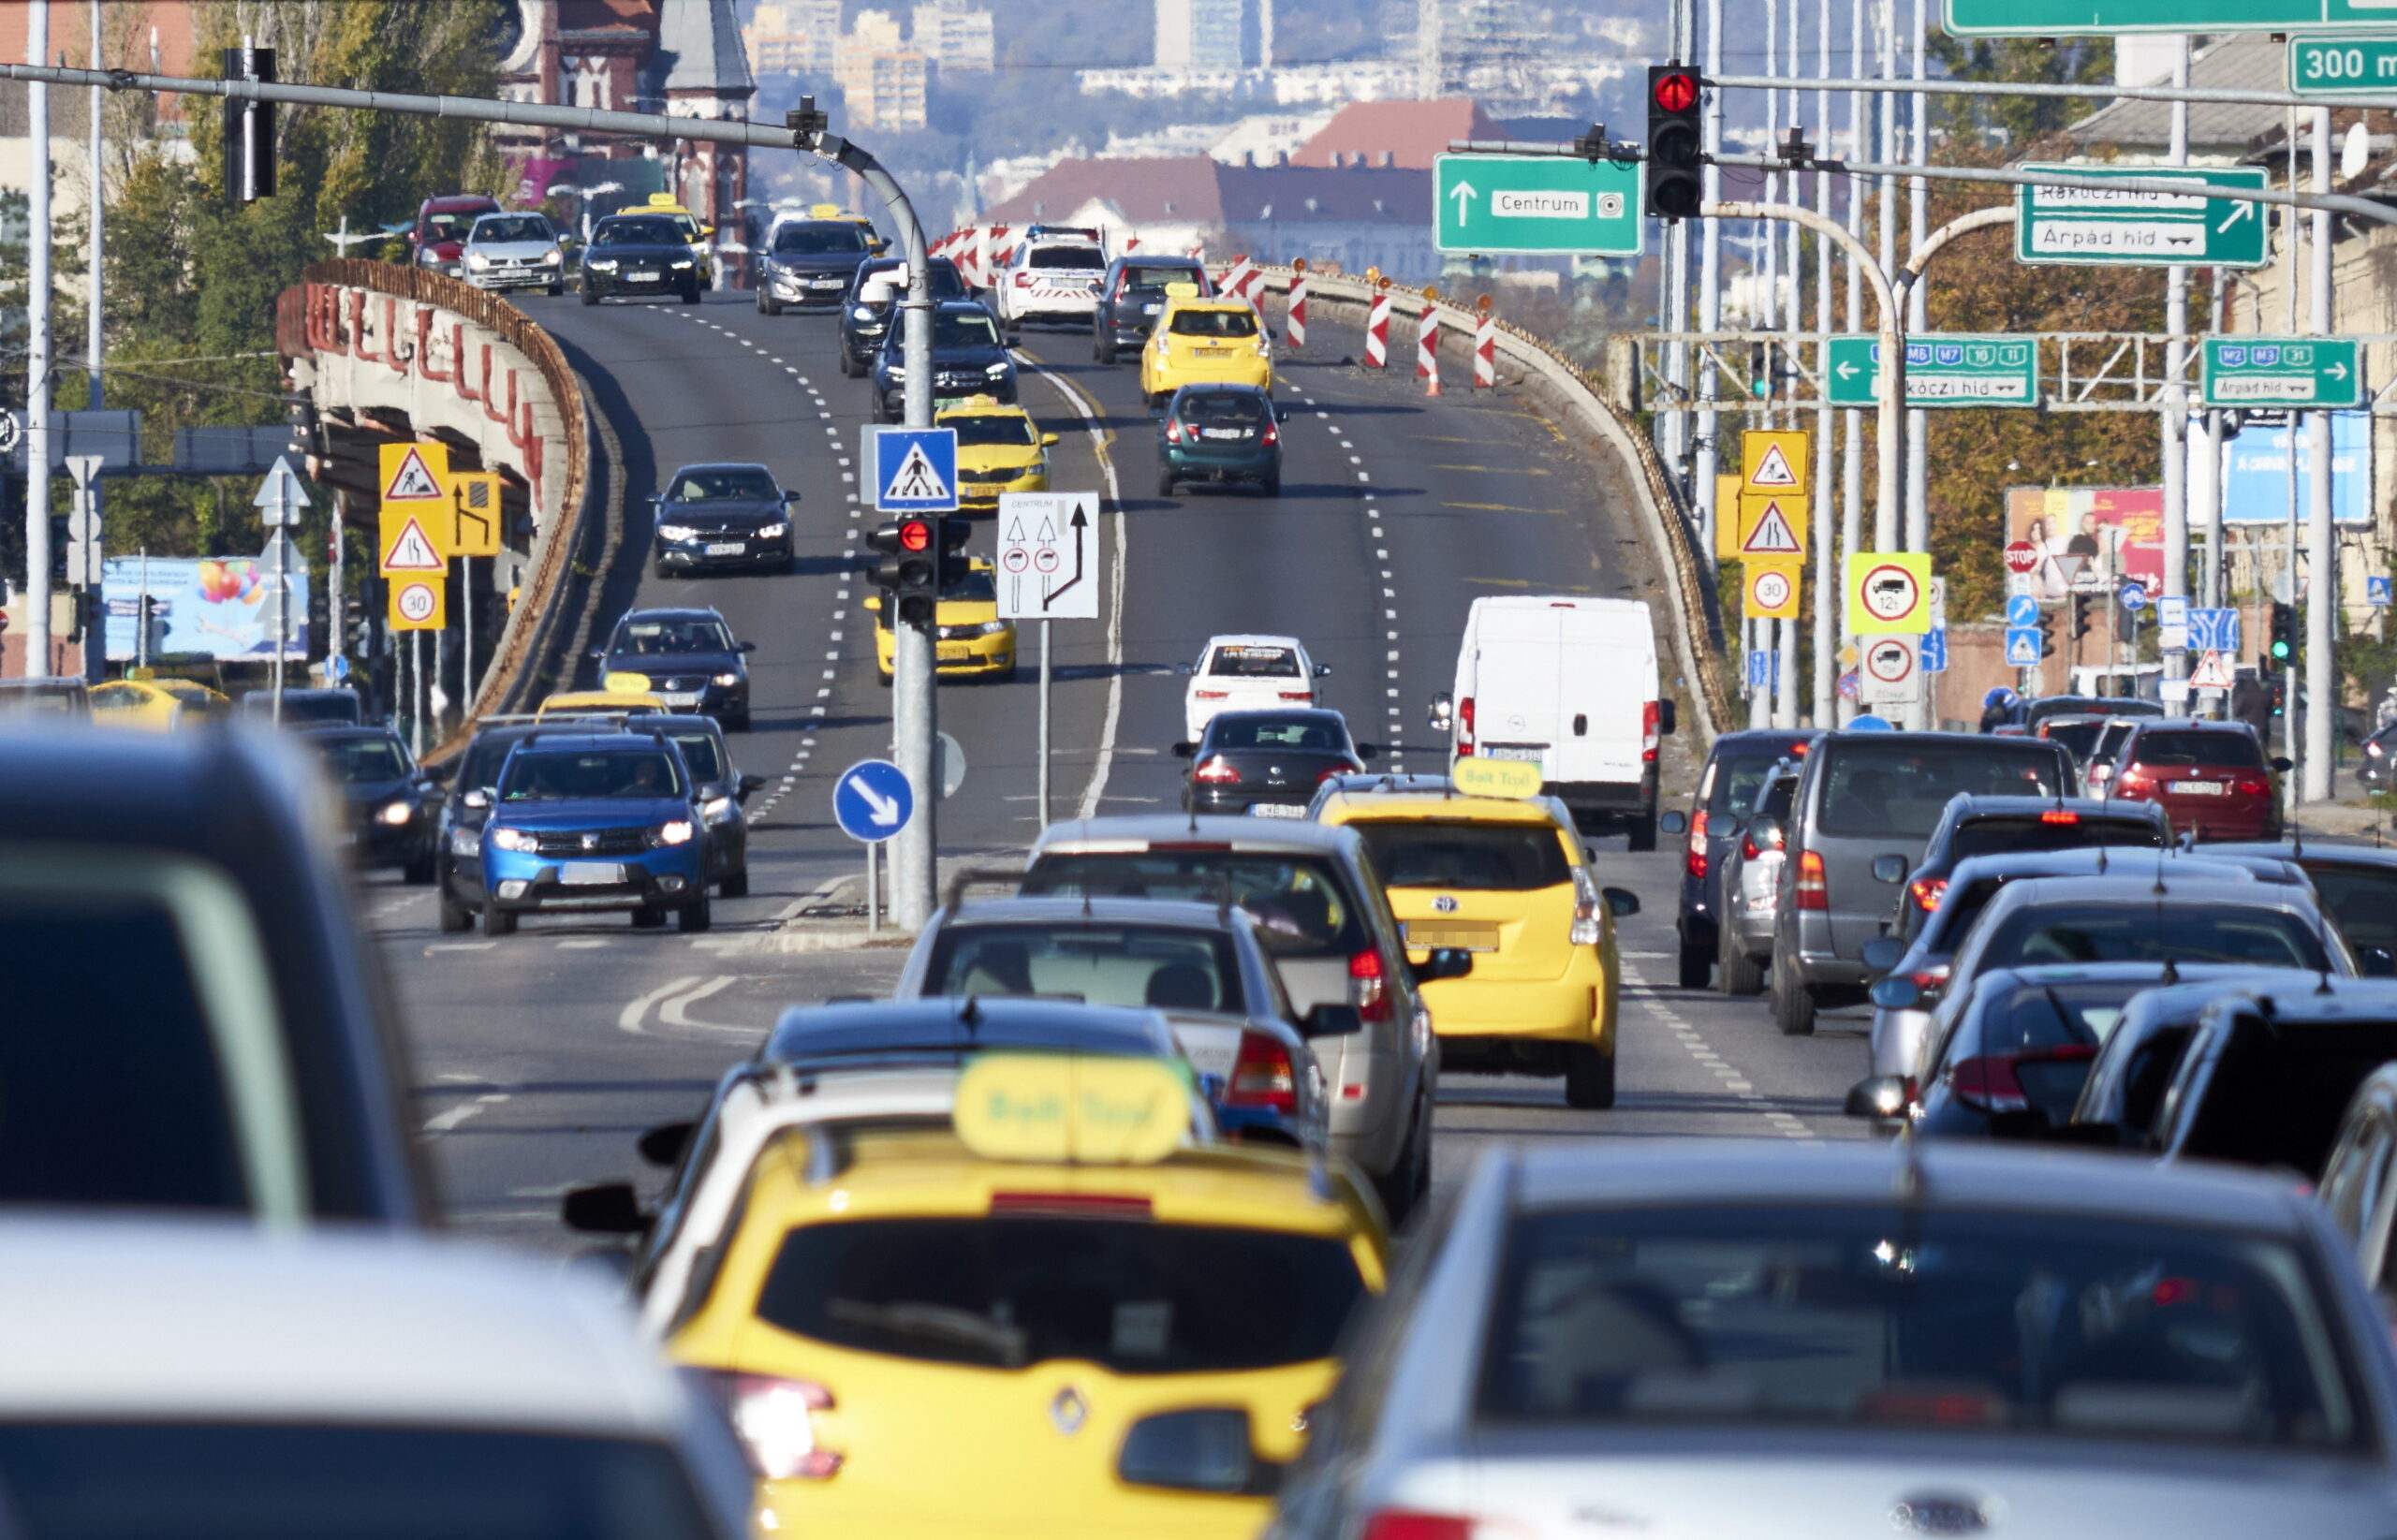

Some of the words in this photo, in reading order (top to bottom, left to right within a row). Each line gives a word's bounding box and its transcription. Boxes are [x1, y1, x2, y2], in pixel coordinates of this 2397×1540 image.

[2305, 49, 2364, 79] 300
[1501, 195, 1580, 212] Centrum
[2043, 224, 2112, 247] Árpád
[1907, 347, 1927, 360] M6
[1940, 349, 1959, 361] M7
[2007, 349, 2019, 361] 11
[2224, 351, 2243, 362] M2
[2256, 351, 2274, 362] M3
[1905, 379, 1955, 396] kóczi
[1011, 500, 1053, 508] CENTRUM
[2005, 549, 2036, 565] STOP
[1763, 583, 1782, 597] 30
[405, 595, 427, 611] 30
[1879, 596, 1899, 610] 12t
